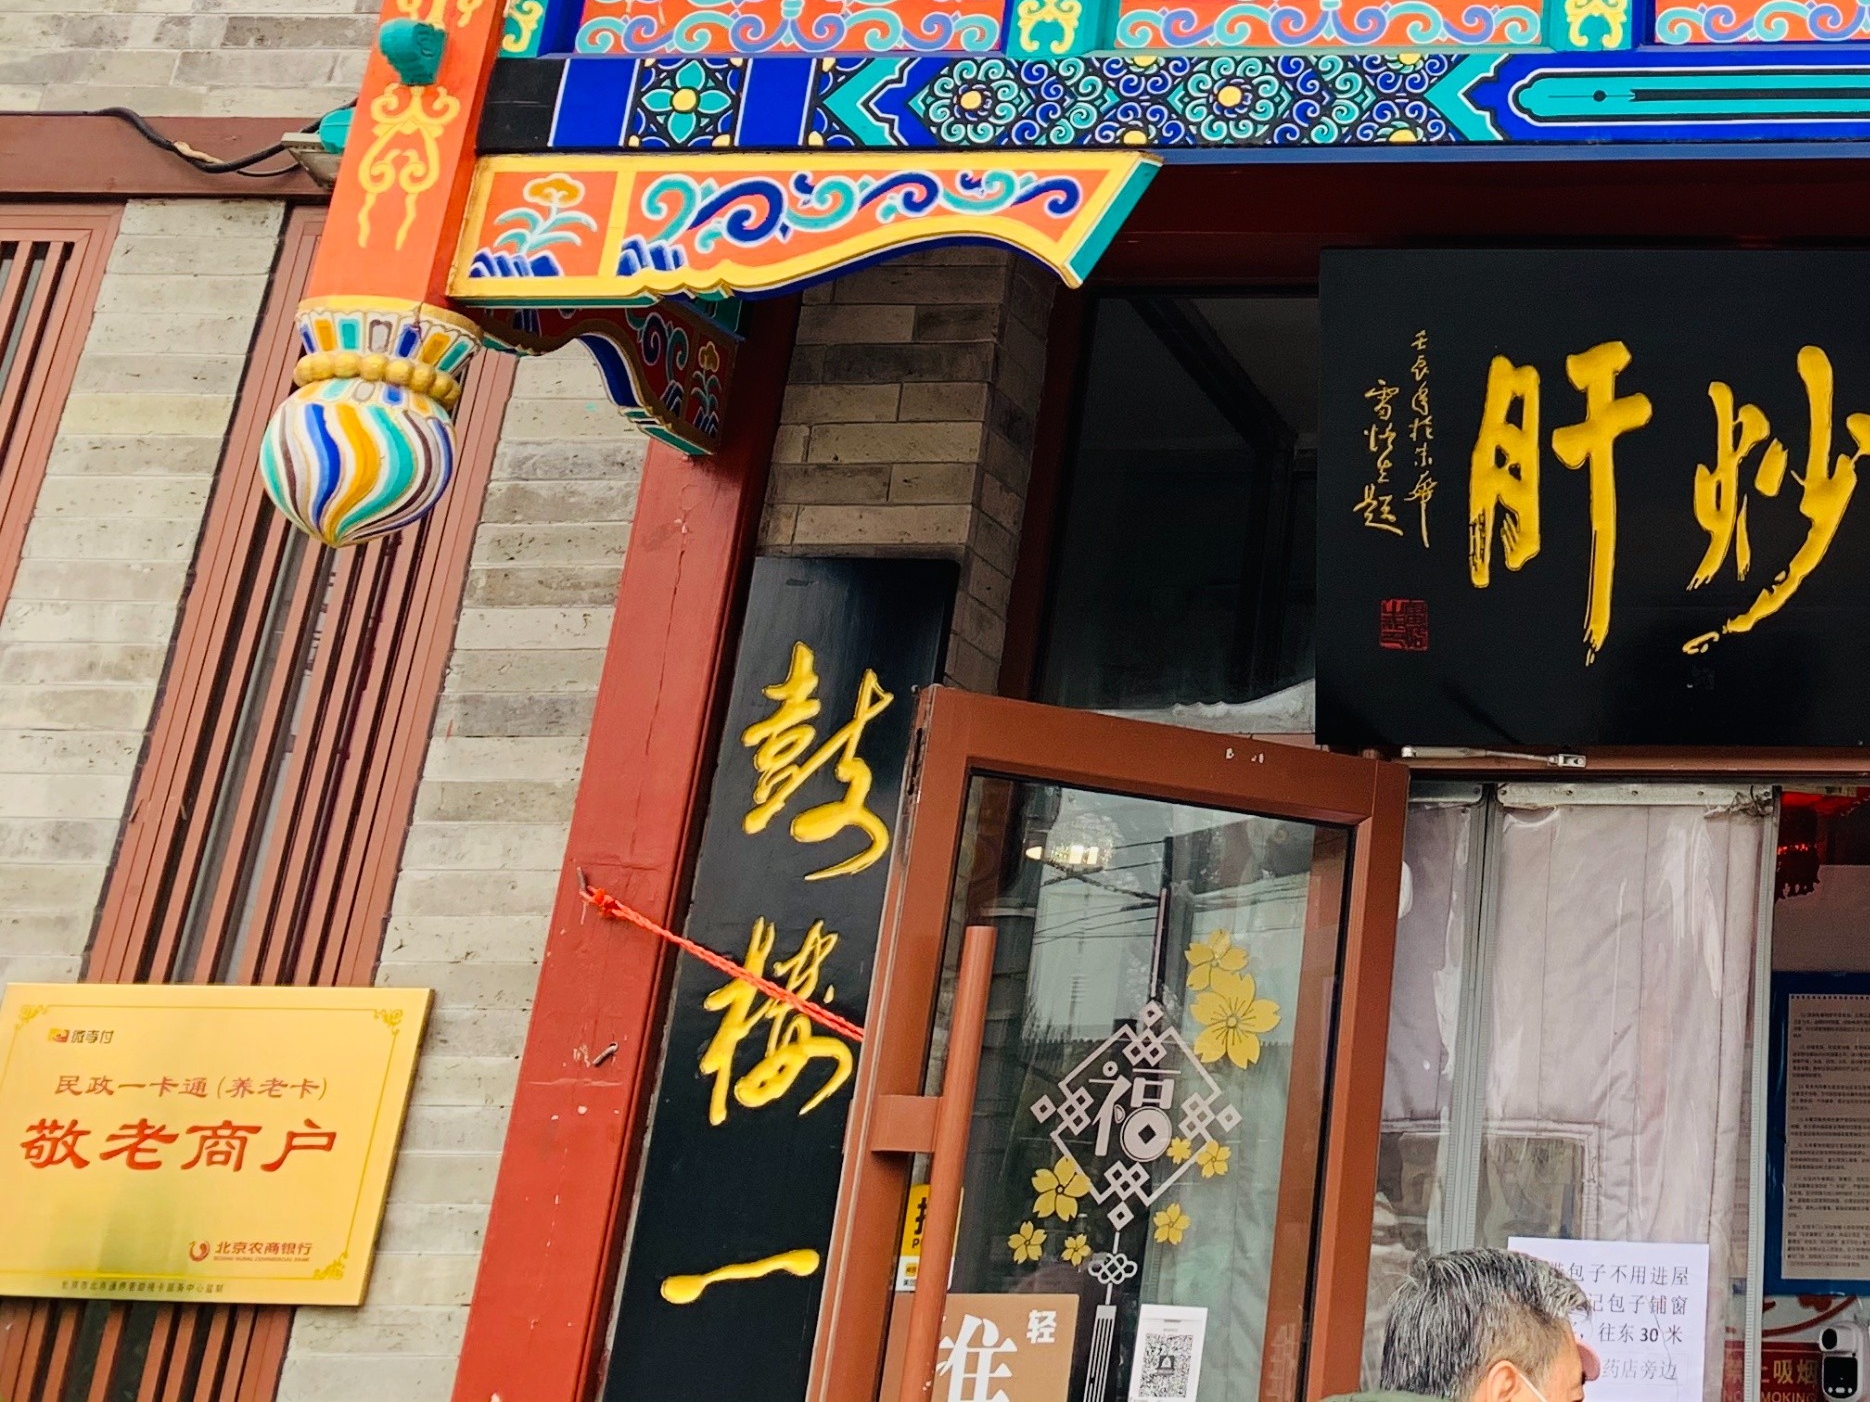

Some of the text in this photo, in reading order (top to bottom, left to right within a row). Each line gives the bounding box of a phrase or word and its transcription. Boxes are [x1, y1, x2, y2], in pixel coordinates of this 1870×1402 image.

[19, 1117, 338, 1173] 敬老商户
[214, 1241, 313, 1256] 北京农商银行
[1026, 1309, 1058, 1344] 轻
